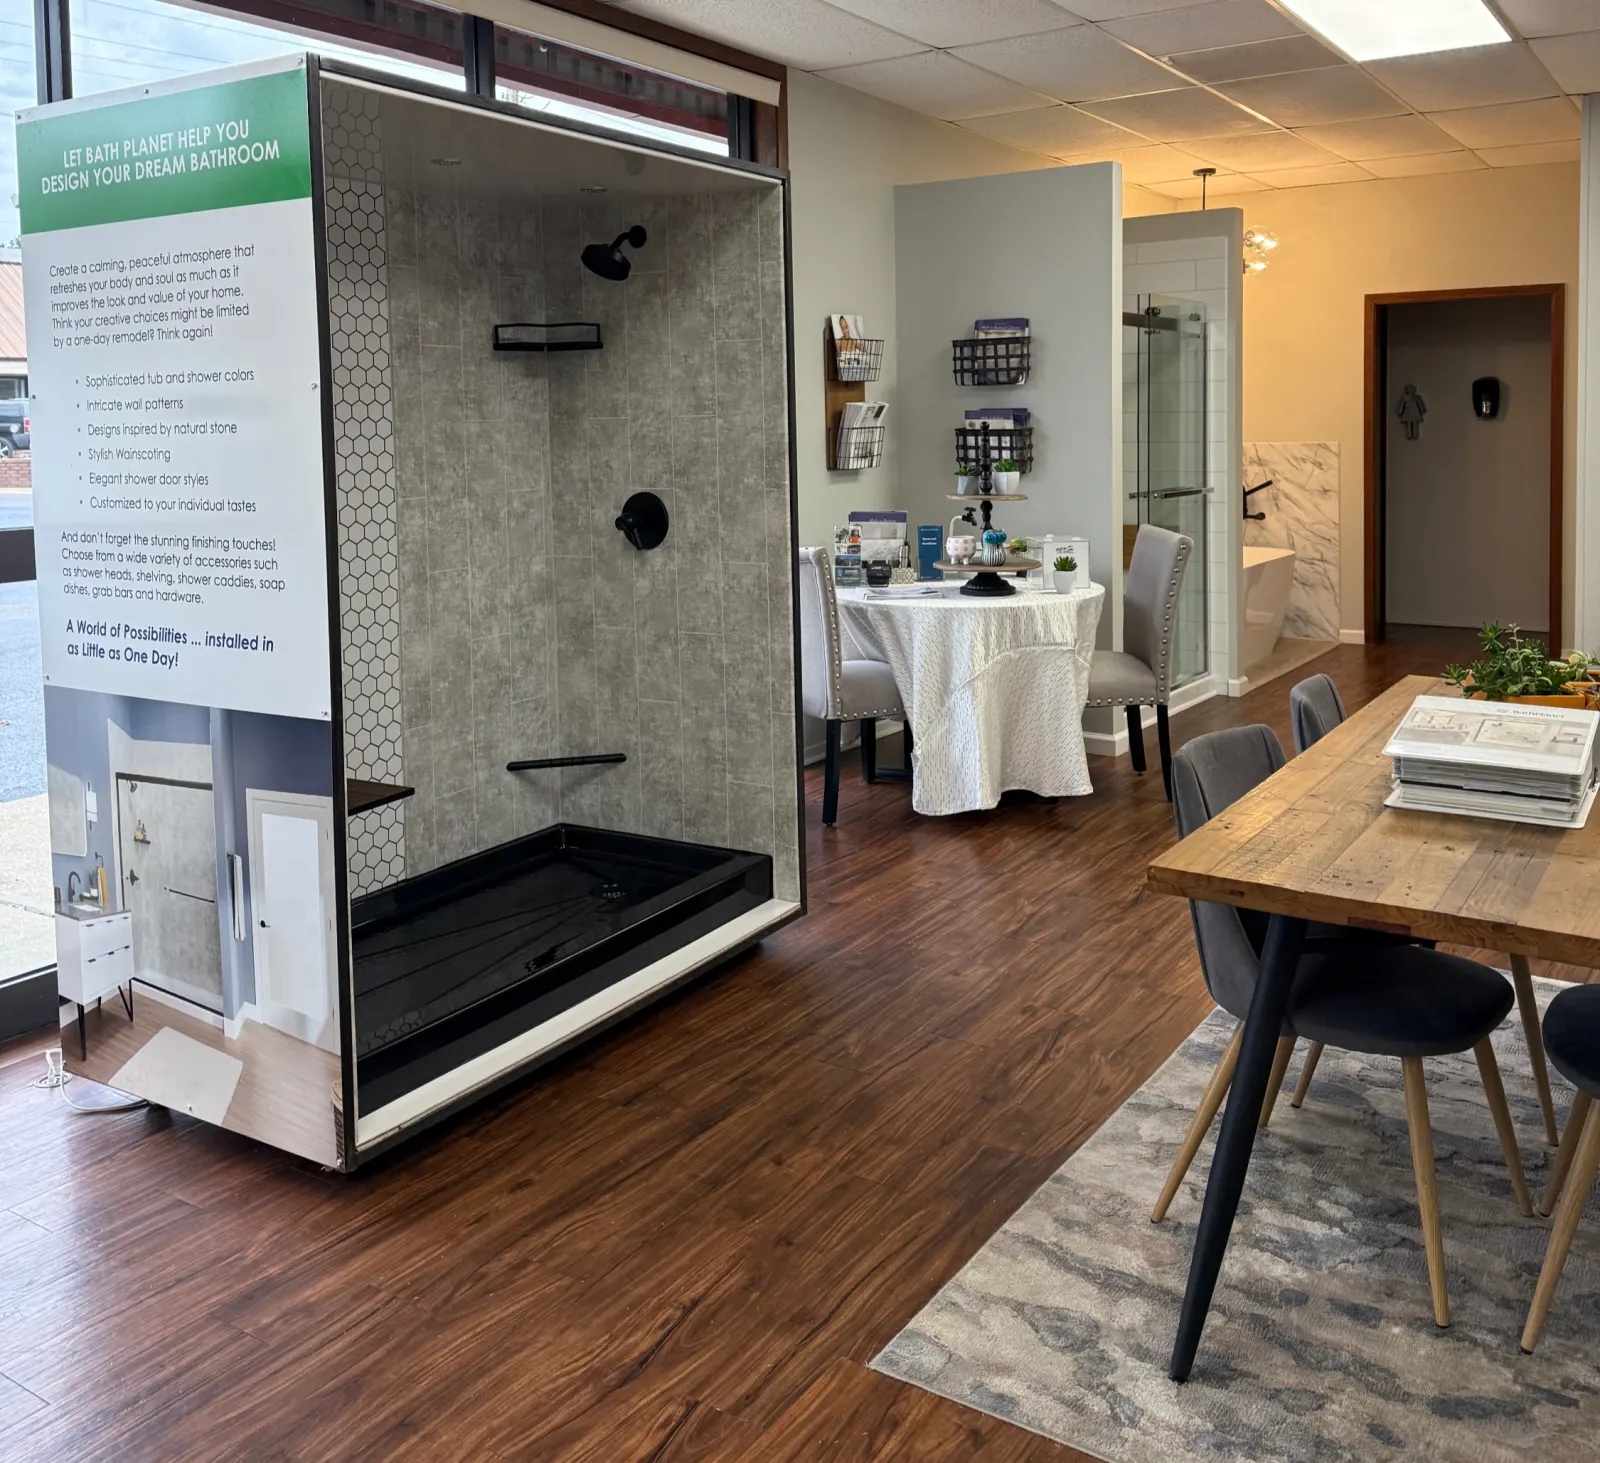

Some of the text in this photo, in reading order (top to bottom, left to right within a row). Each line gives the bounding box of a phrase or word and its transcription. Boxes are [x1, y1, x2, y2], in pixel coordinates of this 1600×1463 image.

[63, 119, 248, 168] LET BATH PLANET HELP YOU
[41, 140, 279, 194] DESIGN YOUR DREAM BATHROOM
[49, 243, 254, 277] Create a calming, peaceful atmosphere that
[50, 264, 239, 294] refreshes your body and soul as much as it
[50, 286, 243, 313] improves the look and value of your home.
[51, 302, 249, 330] Think your creative choices might be limited
[53, 324, 213, 349] by a one-day remodel? Think again!
[85, 368, 254, 389] Sophisticated tub and shower colors
[86, 396, 184, 412] Intricate wall patterns
[87, 421, 237, 438] Designs inspired by natural stone
[88, 447, 170, 463] Stylish Wainscoting
[89, 471, 209, 488] Elegant shower door styles
[89, 496, 256, 512] Customized to your individual tastes
[60, 531, 275, 552] And don't forget the stunning finishing touches!
[61, 547, 278, 570] Choose from a wide variety of accessories such
[62, 566, 285, 592] as shower heads, shelving, shower caddies, soap
[63, 582, 203, 604] dishes, grab bars and hardware.
[66, 618, 73, 632] A
[76, 619, 106, 636] World
[109, 622, 121, 637] of
[123, 623, 187, 644] Possibilities
[205, 630, 258, 650] installed
[262, 635, 273, 652] in
[67, 642, 178, 669] as Little as One Day!
